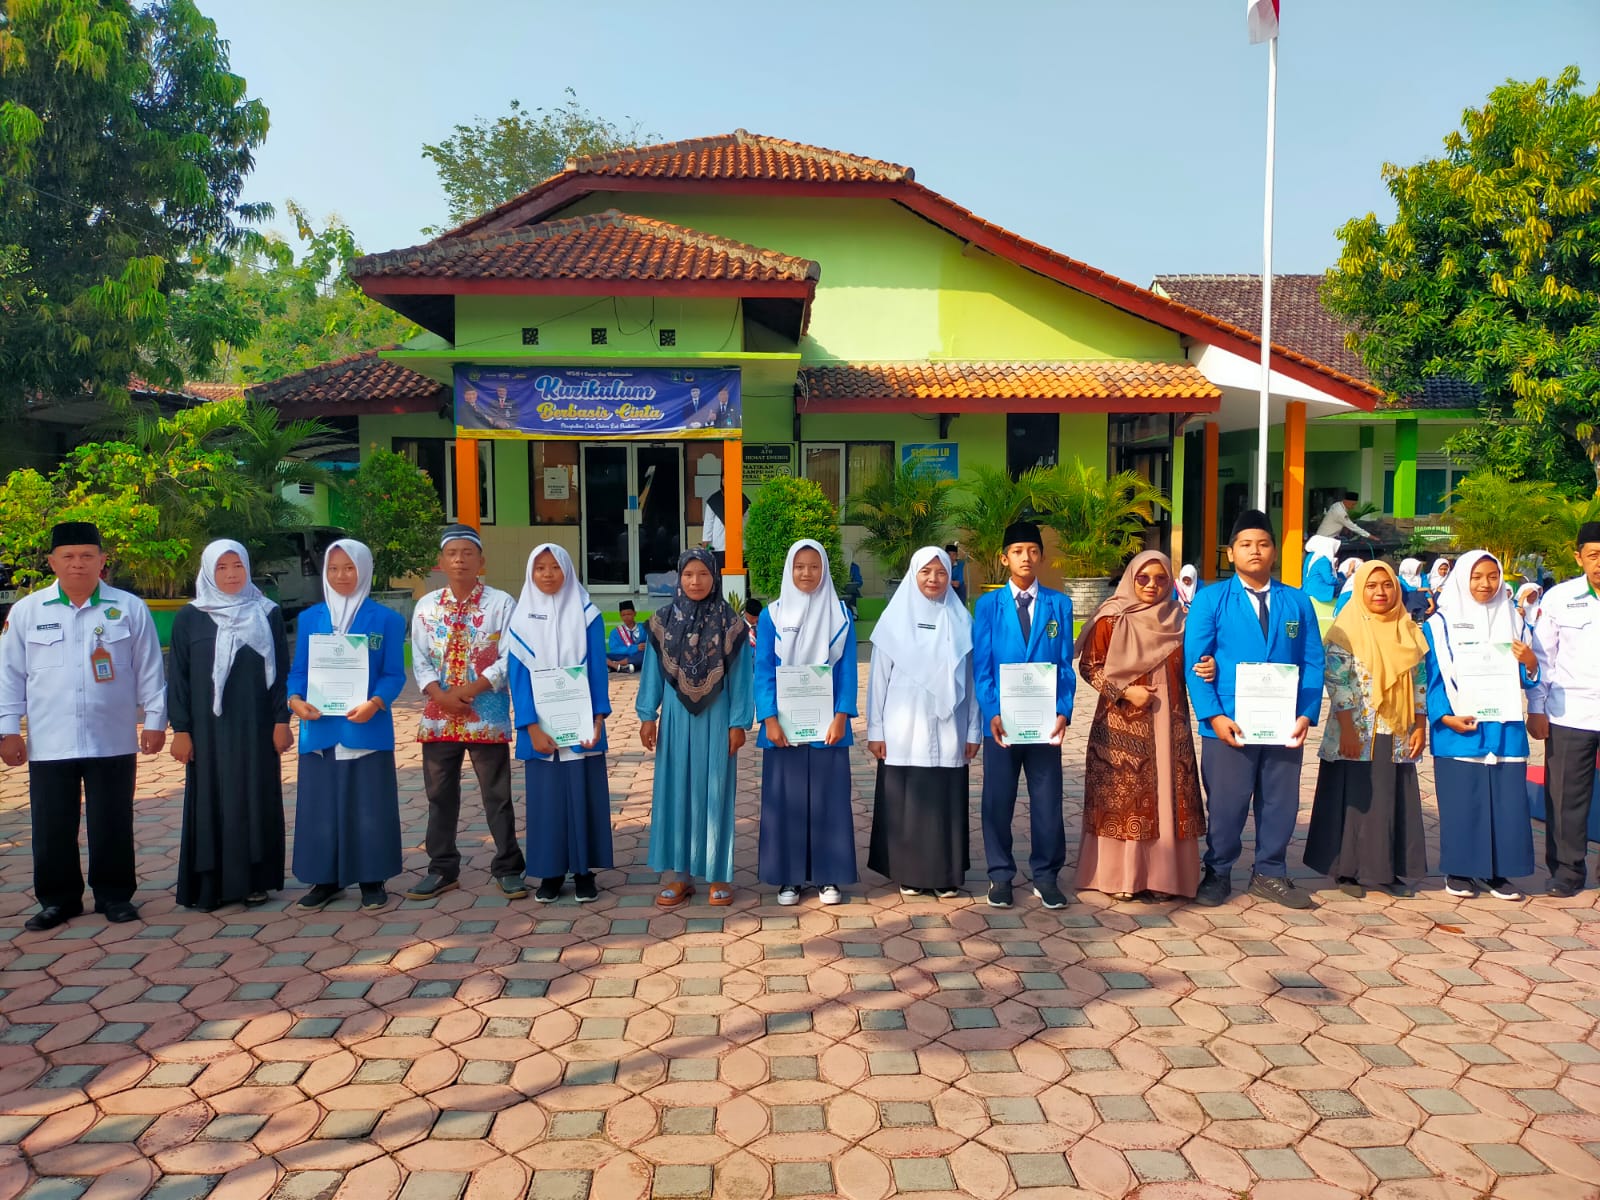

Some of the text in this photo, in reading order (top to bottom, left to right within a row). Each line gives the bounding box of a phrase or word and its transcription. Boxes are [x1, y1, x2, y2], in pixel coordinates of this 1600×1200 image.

[535, 375, 656, 400] Kurikulum
[536, 402, 664, 421] Berbasis Cinta
